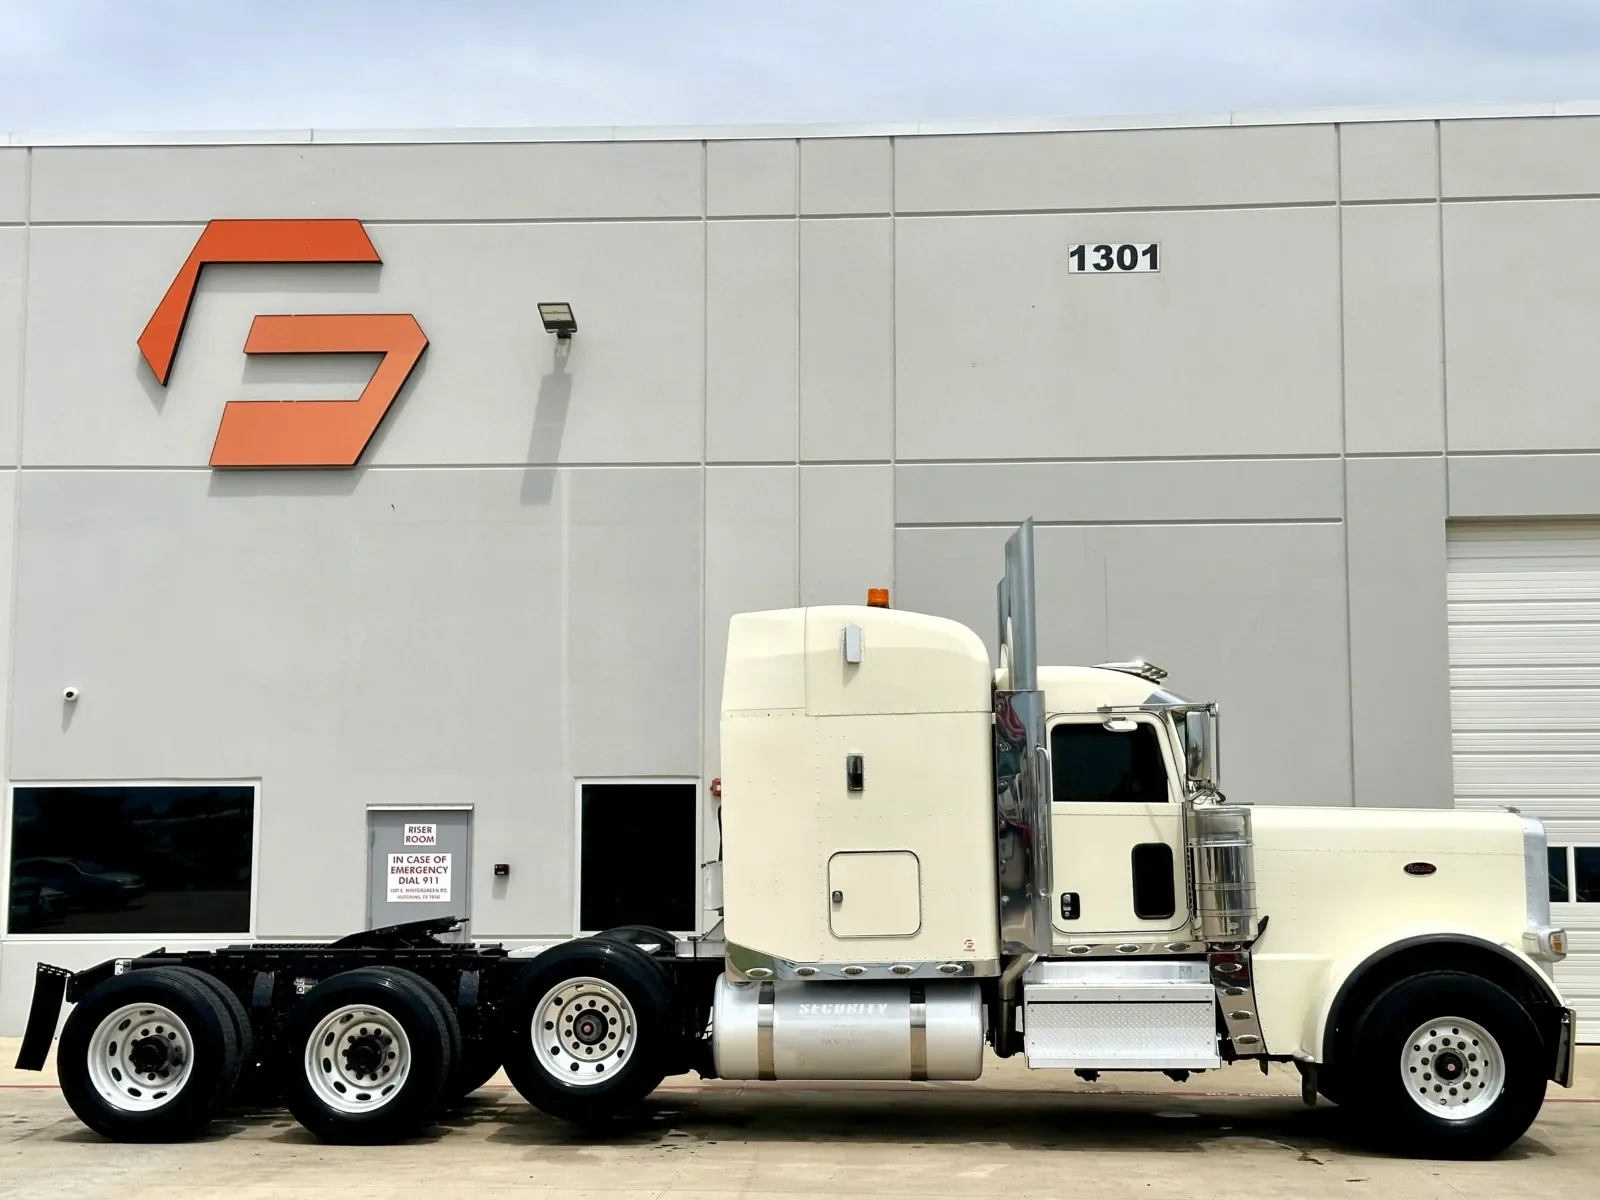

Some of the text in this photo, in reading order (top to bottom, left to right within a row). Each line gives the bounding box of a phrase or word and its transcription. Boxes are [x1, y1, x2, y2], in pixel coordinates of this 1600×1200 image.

[1070, 244, 1158, 271] 1301
[408, 826, 432, 834] RISER
[405, 835, 434, 843] ROOM
[393, 856, 447, 864] IN CASE OF
[390, 866, 448, 874] EMERGENCY
[398, 876, 439, 885] DIAL 911
[799, 1003, 888, 1015] SECURITY
